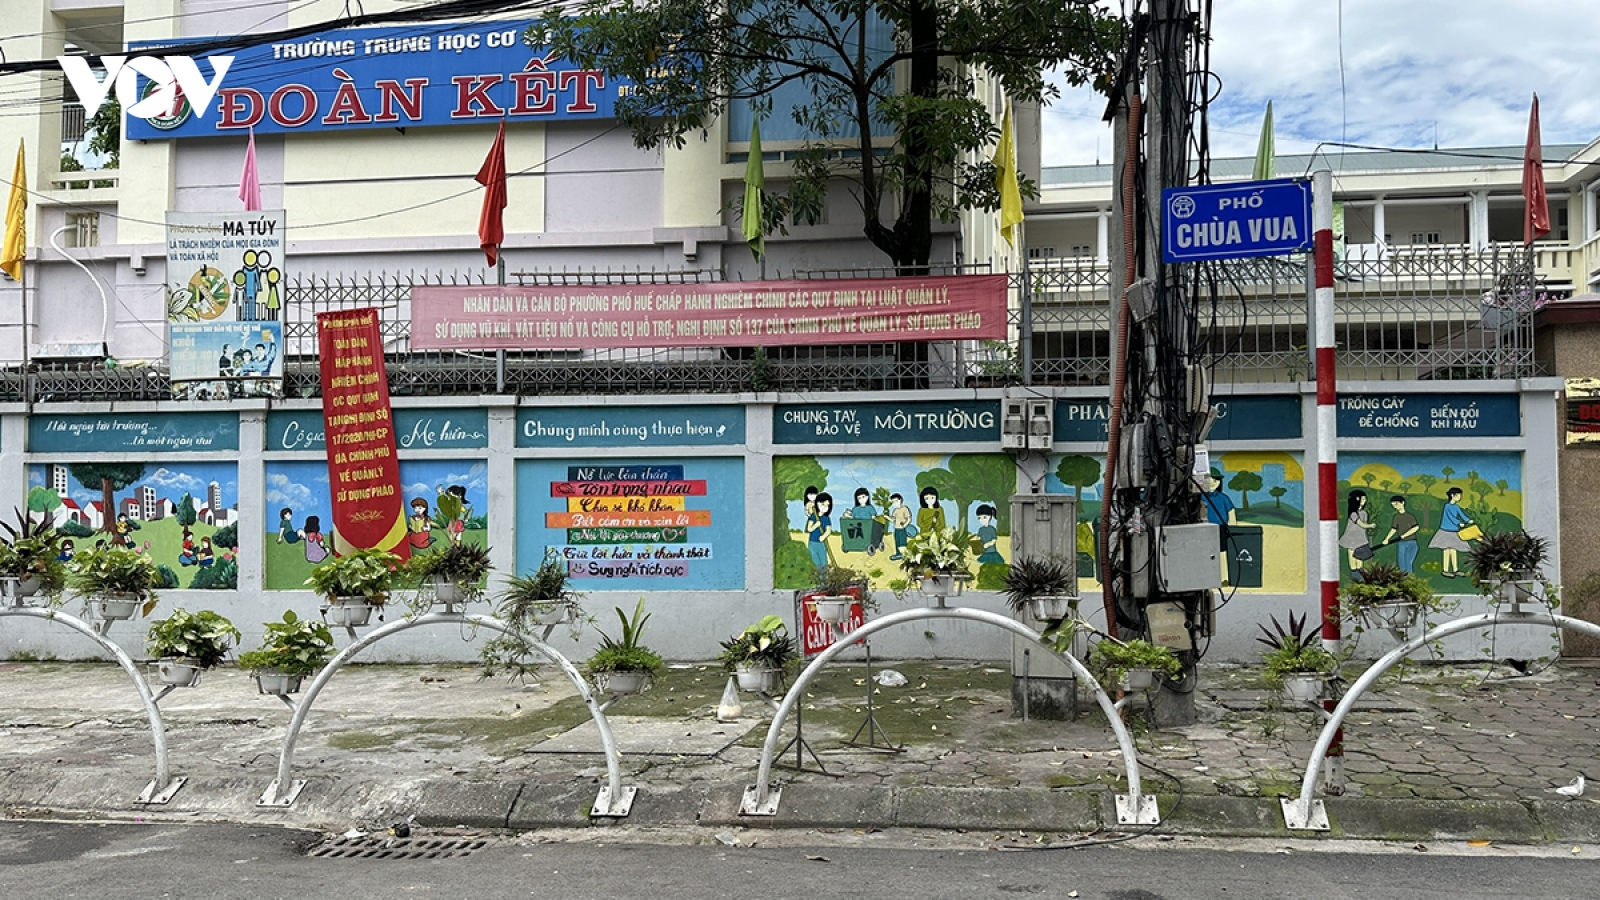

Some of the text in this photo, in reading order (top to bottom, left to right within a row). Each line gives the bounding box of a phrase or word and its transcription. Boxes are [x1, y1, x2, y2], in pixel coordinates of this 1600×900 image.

[271, 37, 355, 60] TRƯỜNG
[363, 36, 431, 55] TRUNG
[438, 31, 480, 54] HỌC
[487, 30, 517, 47] CƠ
[216, 50, 605, 129] ĐOÀN KẾT
[1219, 190, 1265, 210] PHỐ
[223, 221, 245, 236] MA
[248, 215, 277, 235] TÚY
[1177, 216, 1298, 248] CHÙA VUA
[249, 239, 261, 248] GIA
[463, 284, 951, 315] NHÂN DÂN VÀ CÁN BỘ PHƯỜNG PHỐ HUẾ CHẤP HÀNH NGHIÊM CHỈNH CÁC QUY ĐỊNH TẠI LUẬT QUẢN LÝ,
[435, 310, 981, 342] SỬ DỤNG VŨ KHÍ, VẬT LIỆU NỔ VÀ CÔNG CỤ HỖ TRỢ; NGHỊ ĐỊNH SỐ 137 CỦA CHÍNH PHỦ VỀ QUẢN LÝ, SỬ DỤNG PHÁO
[1339, 395, 1380, 410] TRỒNG
[1431, 401, 1480, 418] BIẾN ĐỔI
[783, 410, 857, 424] CHUNG TAY
[874, 407, 994, 430] MÔI TRƯỜNG
[1358, 410, 1419, 428] ĐỂ CHỐNG
[1431, 418, 1477, 430] KHÍ HẬU
[524, 420, 575, 442] Chúng
[613, 424, 647, 441] cùng
[651, 420, 682, 437] thực
[816, 420, 861, 437] BẢO VỆ
[653, 480, 692, 495] nhau
[588, 561, 614, 578] Suy
